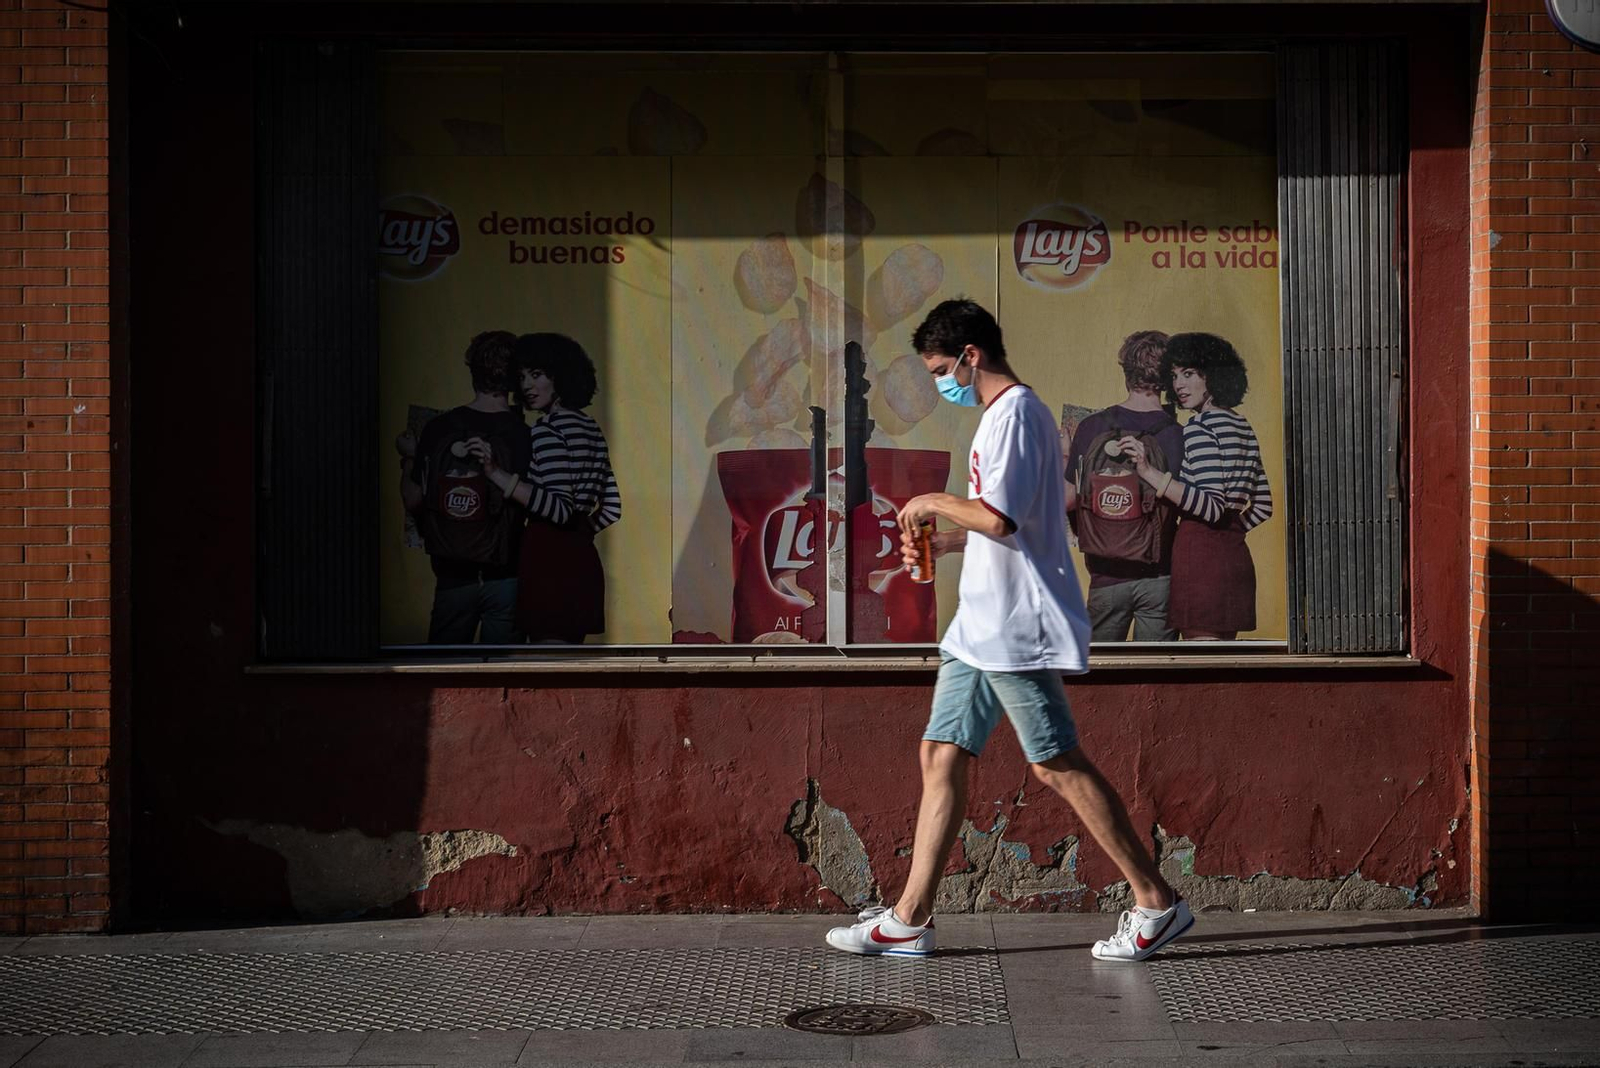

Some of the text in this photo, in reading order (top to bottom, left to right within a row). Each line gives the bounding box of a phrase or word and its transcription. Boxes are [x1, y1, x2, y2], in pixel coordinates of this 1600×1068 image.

[478, 211, 655, 235] demasiado
[1124, 220, 1279, 243] Ponle sab
[509, 241, 625, 264] buenas
[1019, 222, 1105, 276] Lay's
[1152, 245, 1278, 269] a la vida
